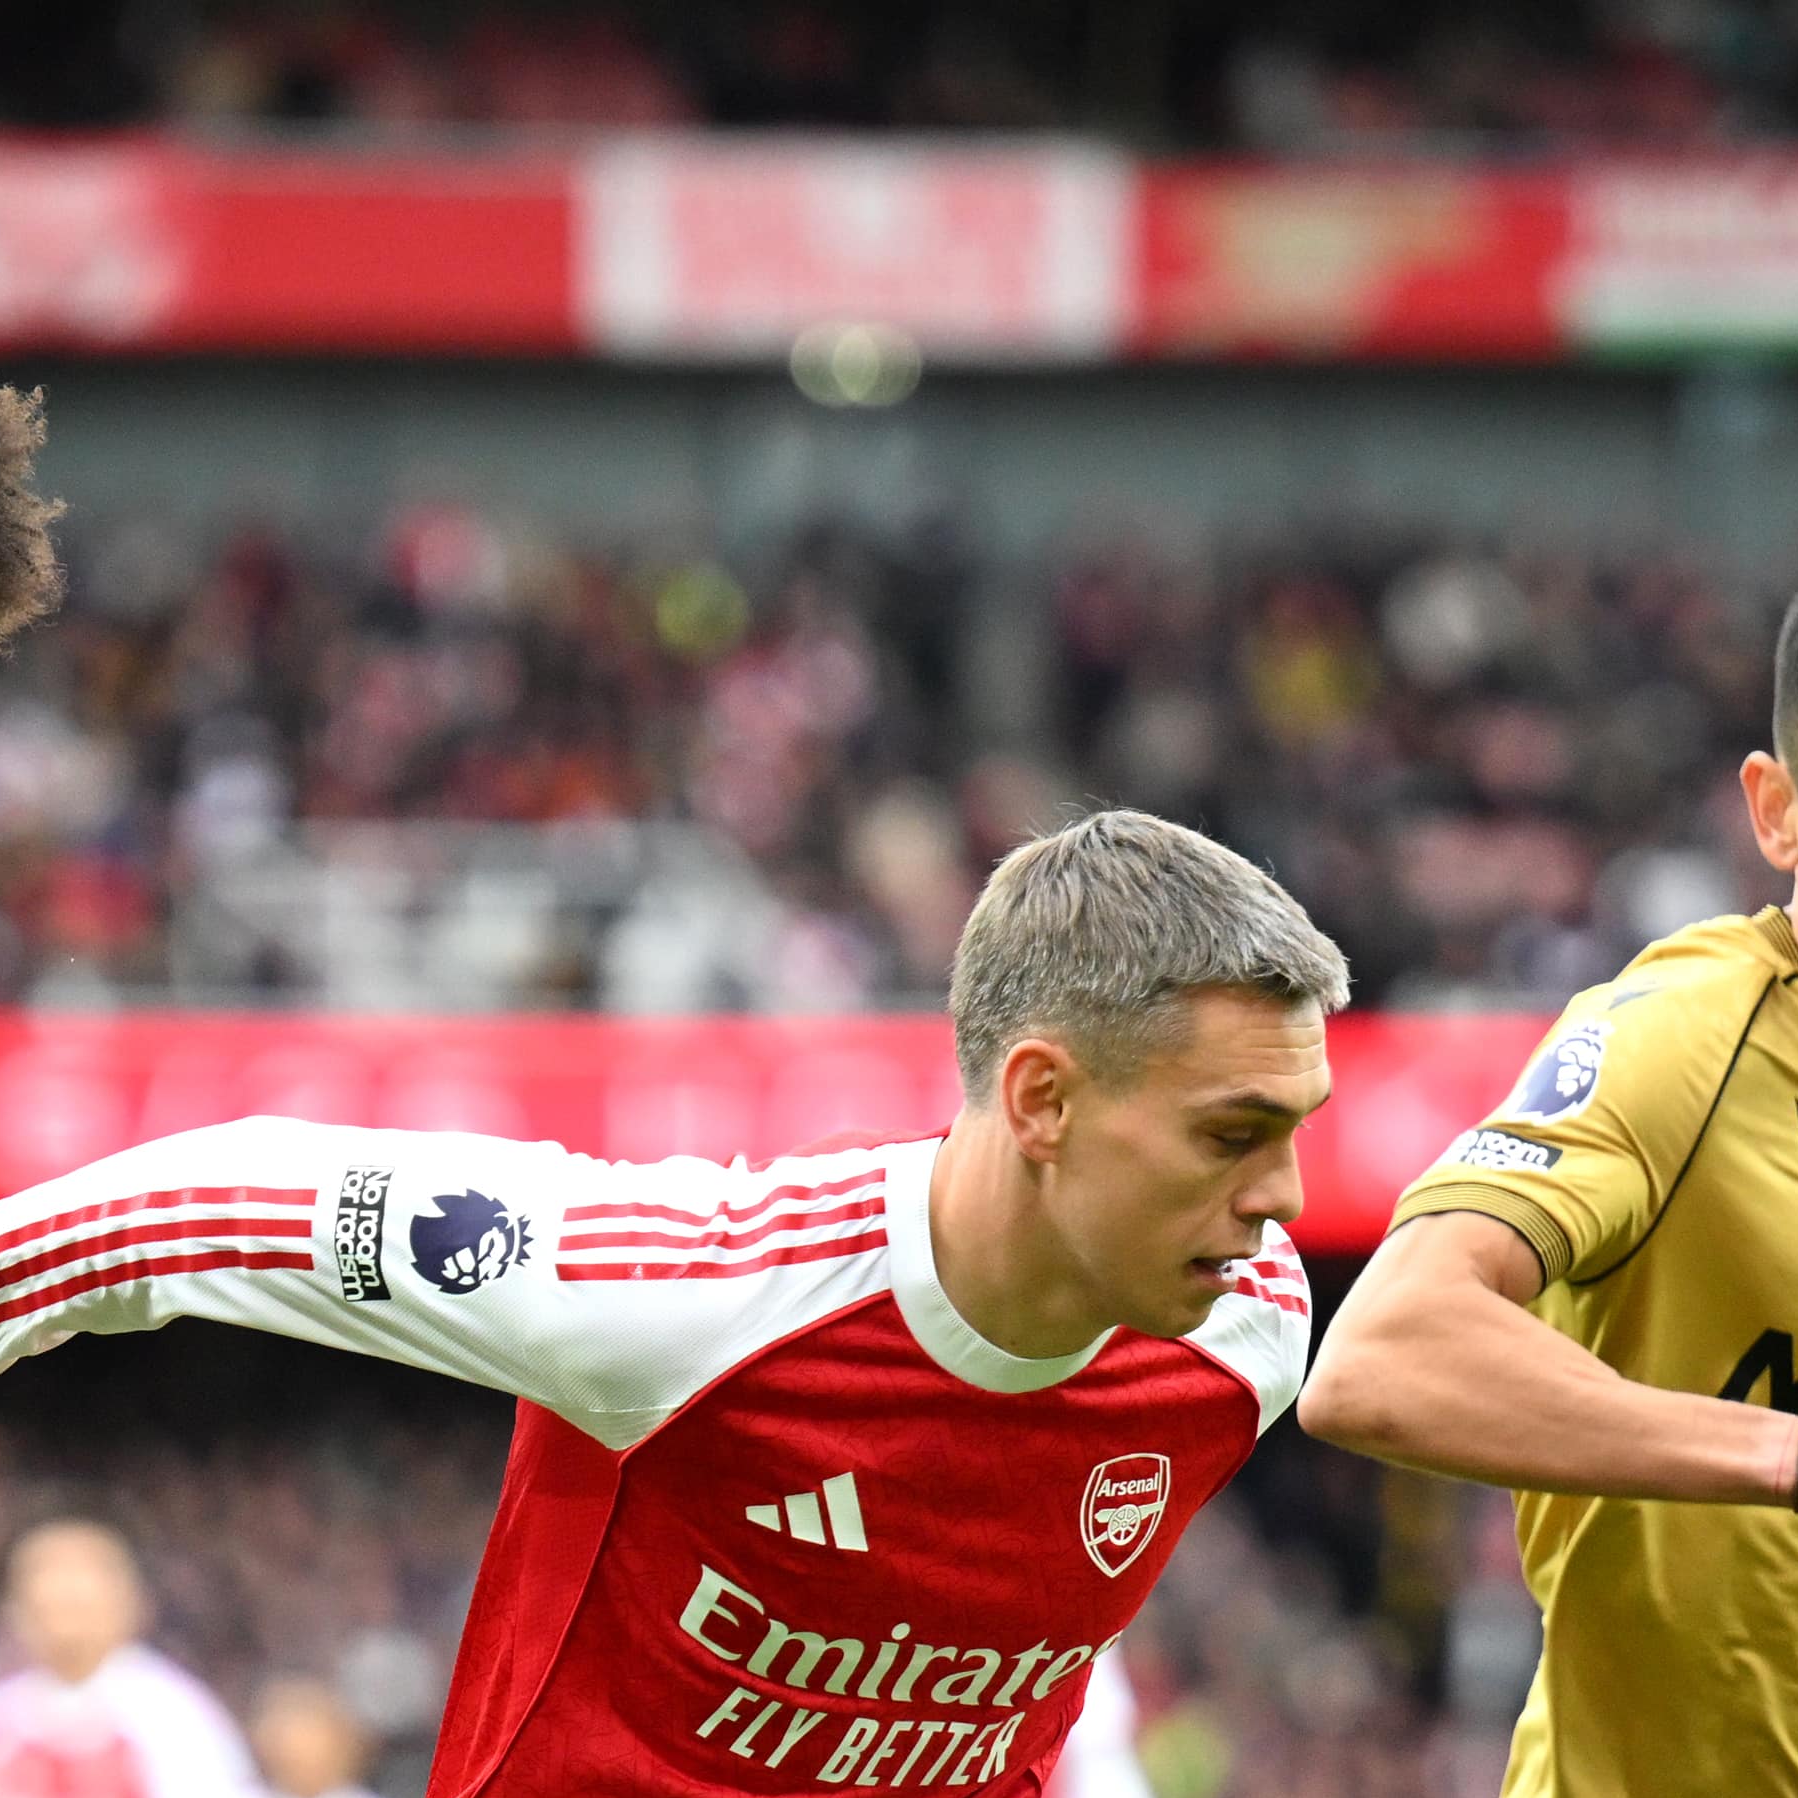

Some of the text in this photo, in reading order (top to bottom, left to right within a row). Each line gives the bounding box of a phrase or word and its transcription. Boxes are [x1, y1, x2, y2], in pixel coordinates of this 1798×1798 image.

[1477, 1131, 1549, 1165] room
[336, 1167, 364, 1300] for racism
[356, 1167, 395, 1287] No room
[1096, 1472, 1159, 1497] Arsenal
[696, 1686, 1026, 1787] FLY BETTER
